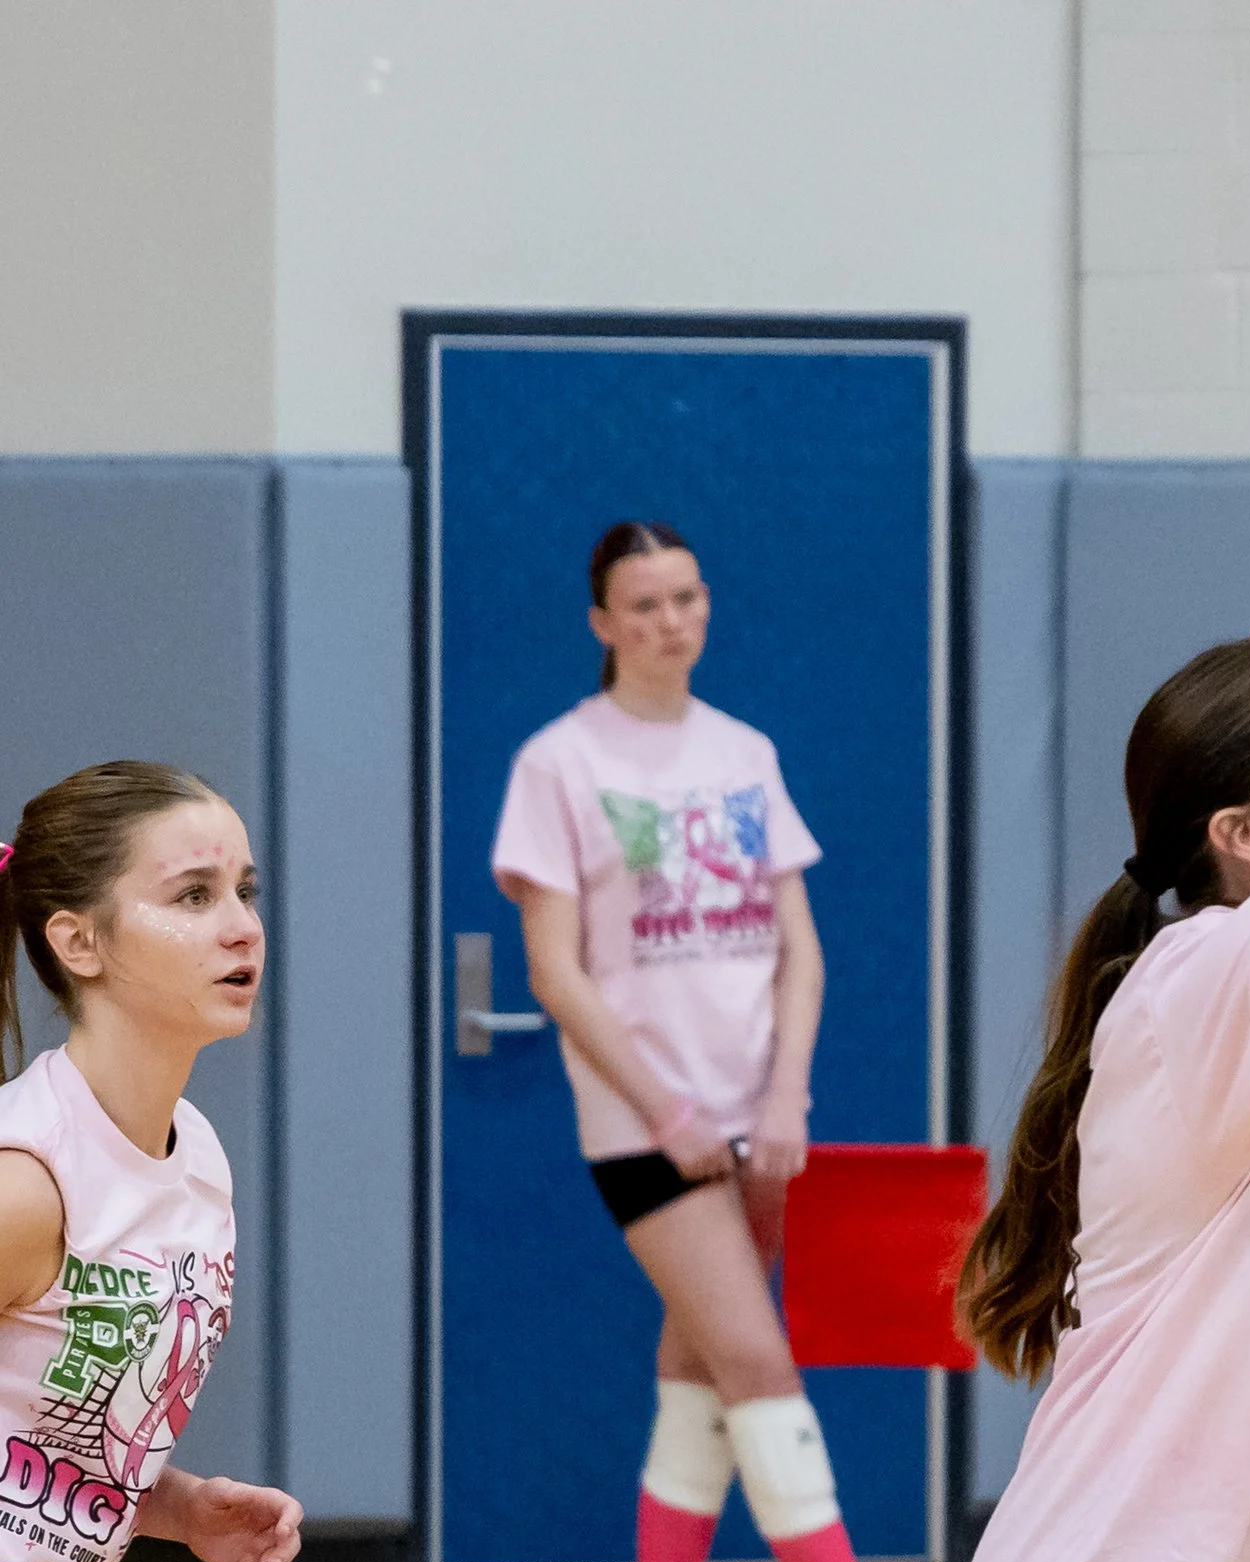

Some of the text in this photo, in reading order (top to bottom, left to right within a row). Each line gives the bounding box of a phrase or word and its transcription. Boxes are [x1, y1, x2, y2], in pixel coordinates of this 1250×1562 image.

[62, 1309, 92, 1379] PIRATES
[0, 1436, 129, 1546] DIG
[0, 1509, 28, 1536] ALS
[28, 1524, 46, 1545] ON
[49, 1532, 70, 1557] THE
